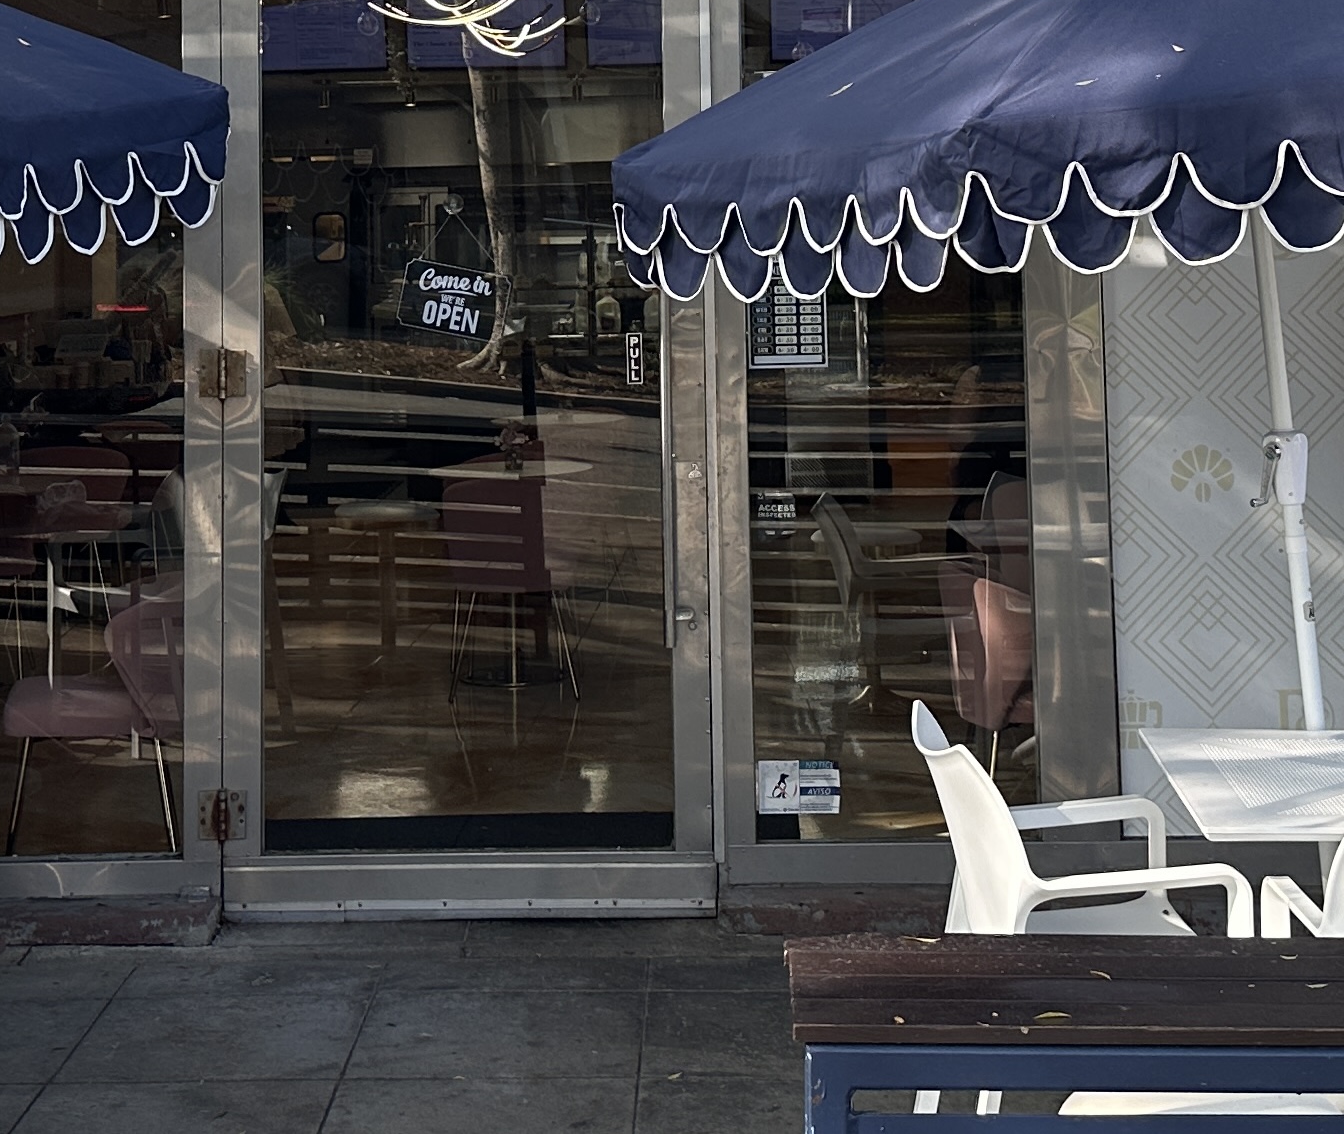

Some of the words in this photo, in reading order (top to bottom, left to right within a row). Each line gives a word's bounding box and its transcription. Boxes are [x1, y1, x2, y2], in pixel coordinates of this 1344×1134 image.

[418, 268, 472, 291] Come
[473, 276, 492, 296] in
[422, 300, 480, 334] OPEN
[630, 336, 640, 380] PULL
[758, 504, 796, 512] ACCESS
